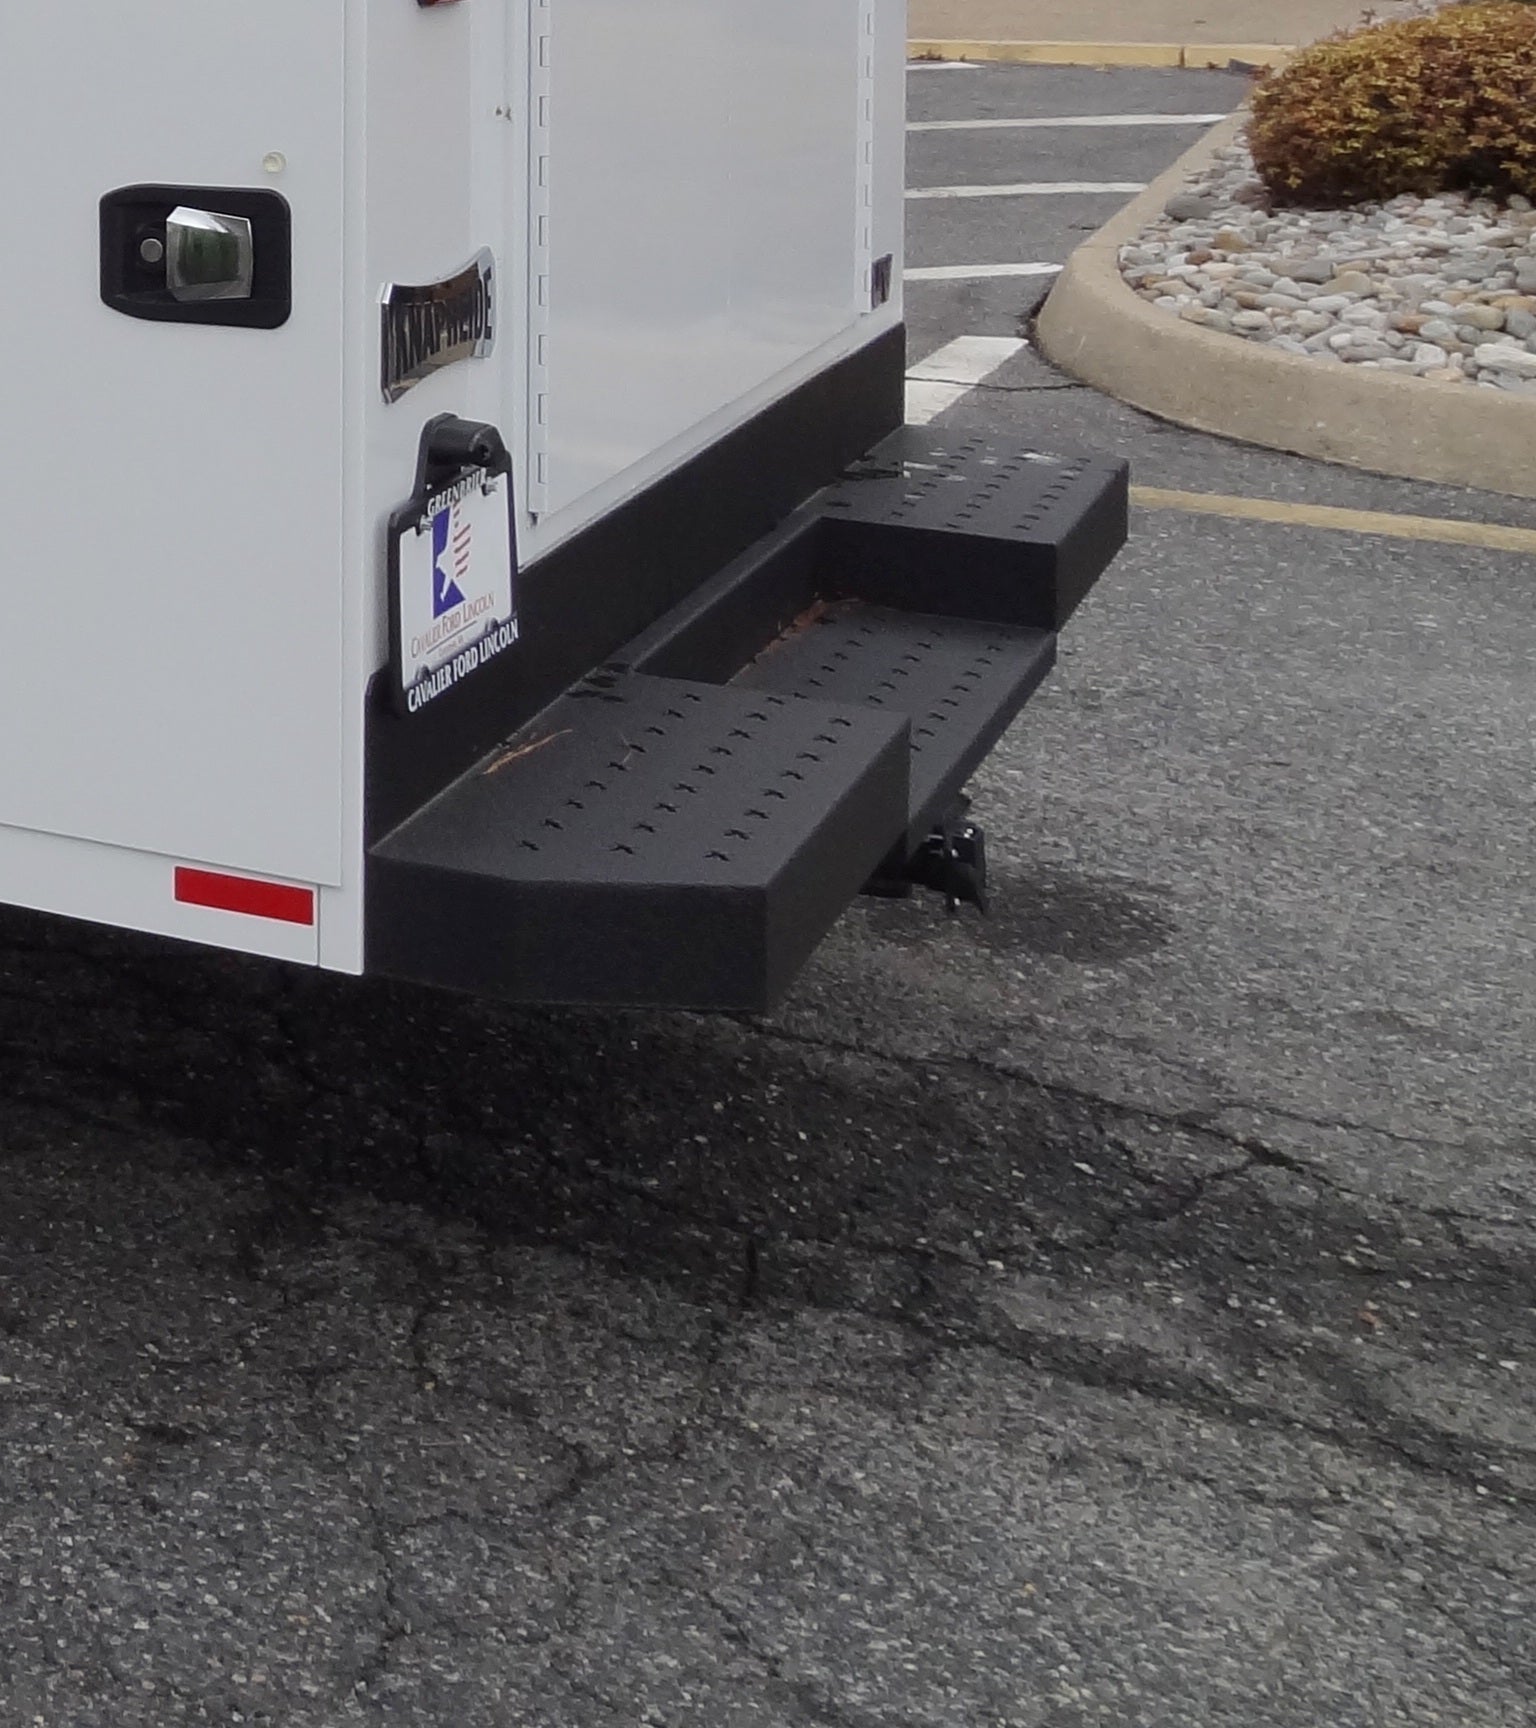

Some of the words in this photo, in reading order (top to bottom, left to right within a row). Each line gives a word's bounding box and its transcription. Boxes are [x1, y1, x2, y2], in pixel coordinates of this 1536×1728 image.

[408, 665, 453, 712] CAVALIER
[453, 647, 478, 682] FORD
[479, 618, 519, 663] LINCOLN
